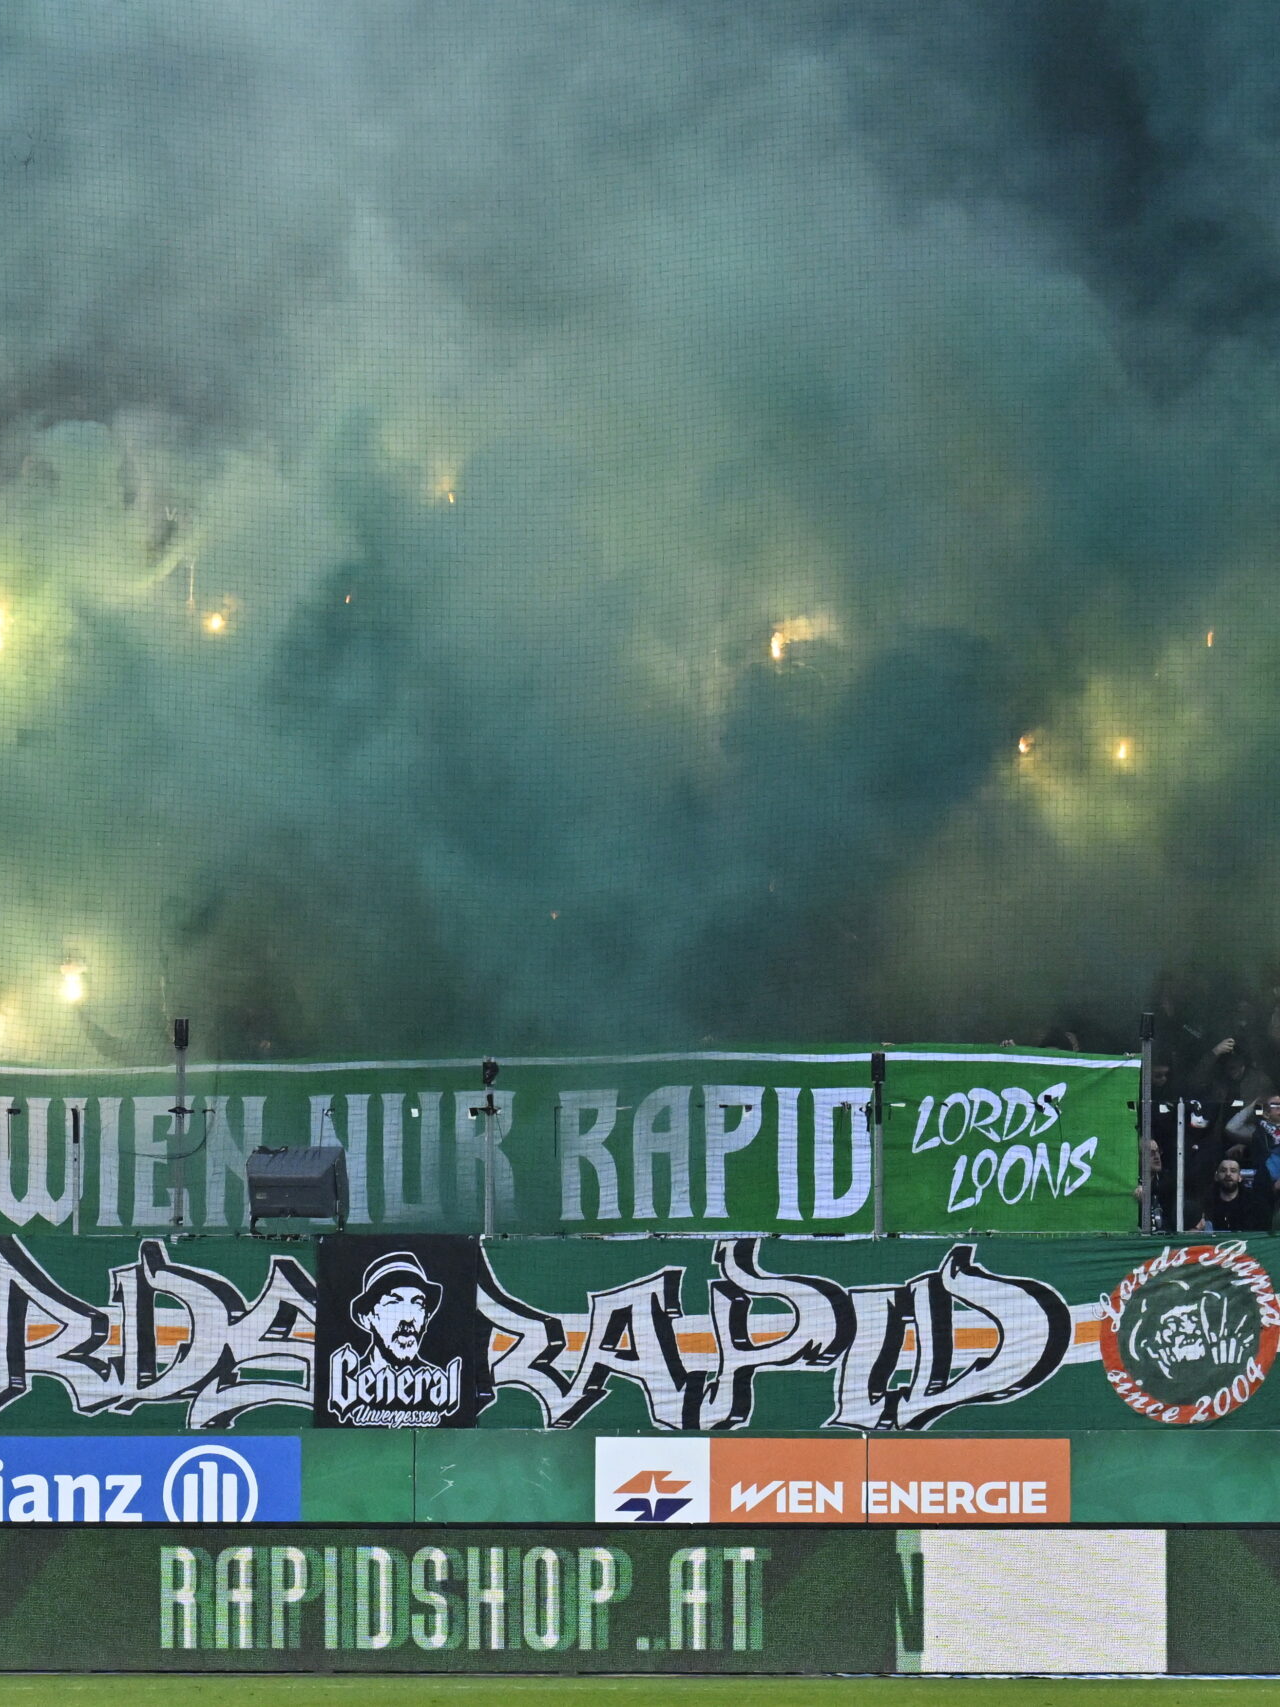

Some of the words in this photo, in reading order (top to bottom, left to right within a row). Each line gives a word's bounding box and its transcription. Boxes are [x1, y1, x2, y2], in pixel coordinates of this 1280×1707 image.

[558, 1084, 874, 1221] RAPID
[912, 1082, 1067, 1153] LORDS
[947, 1136, 1098, 1213] LOONS
[477, 1235, 1072, 1430] RAPID
[328, 1343, 462, 1416] General
[351, 1402, 441, 1428] Unvergessen
[1189, 1357, 1265, 1423] 2004
[730, 1480, 843, 1513] WIEN
[861, 1481, 1047, 1514] ENERGIE
